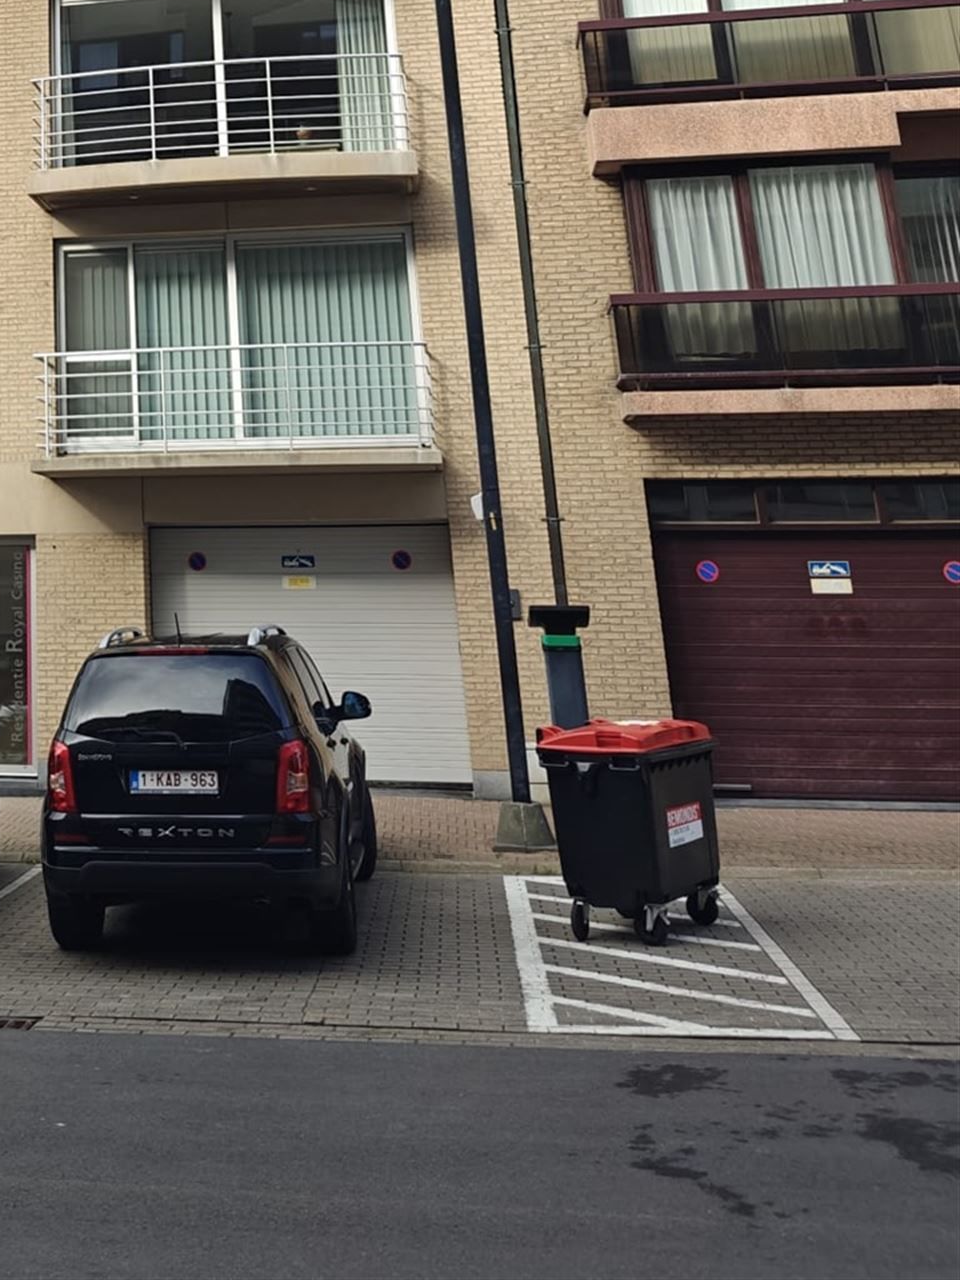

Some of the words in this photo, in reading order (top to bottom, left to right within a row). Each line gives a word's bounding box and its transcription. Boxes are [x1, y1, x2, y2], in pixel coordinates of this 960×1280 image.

[11, 552, 23, 600] Casino
[5, 606, 25, 652] Royal
[118, 826, 235, 837] REXTON
